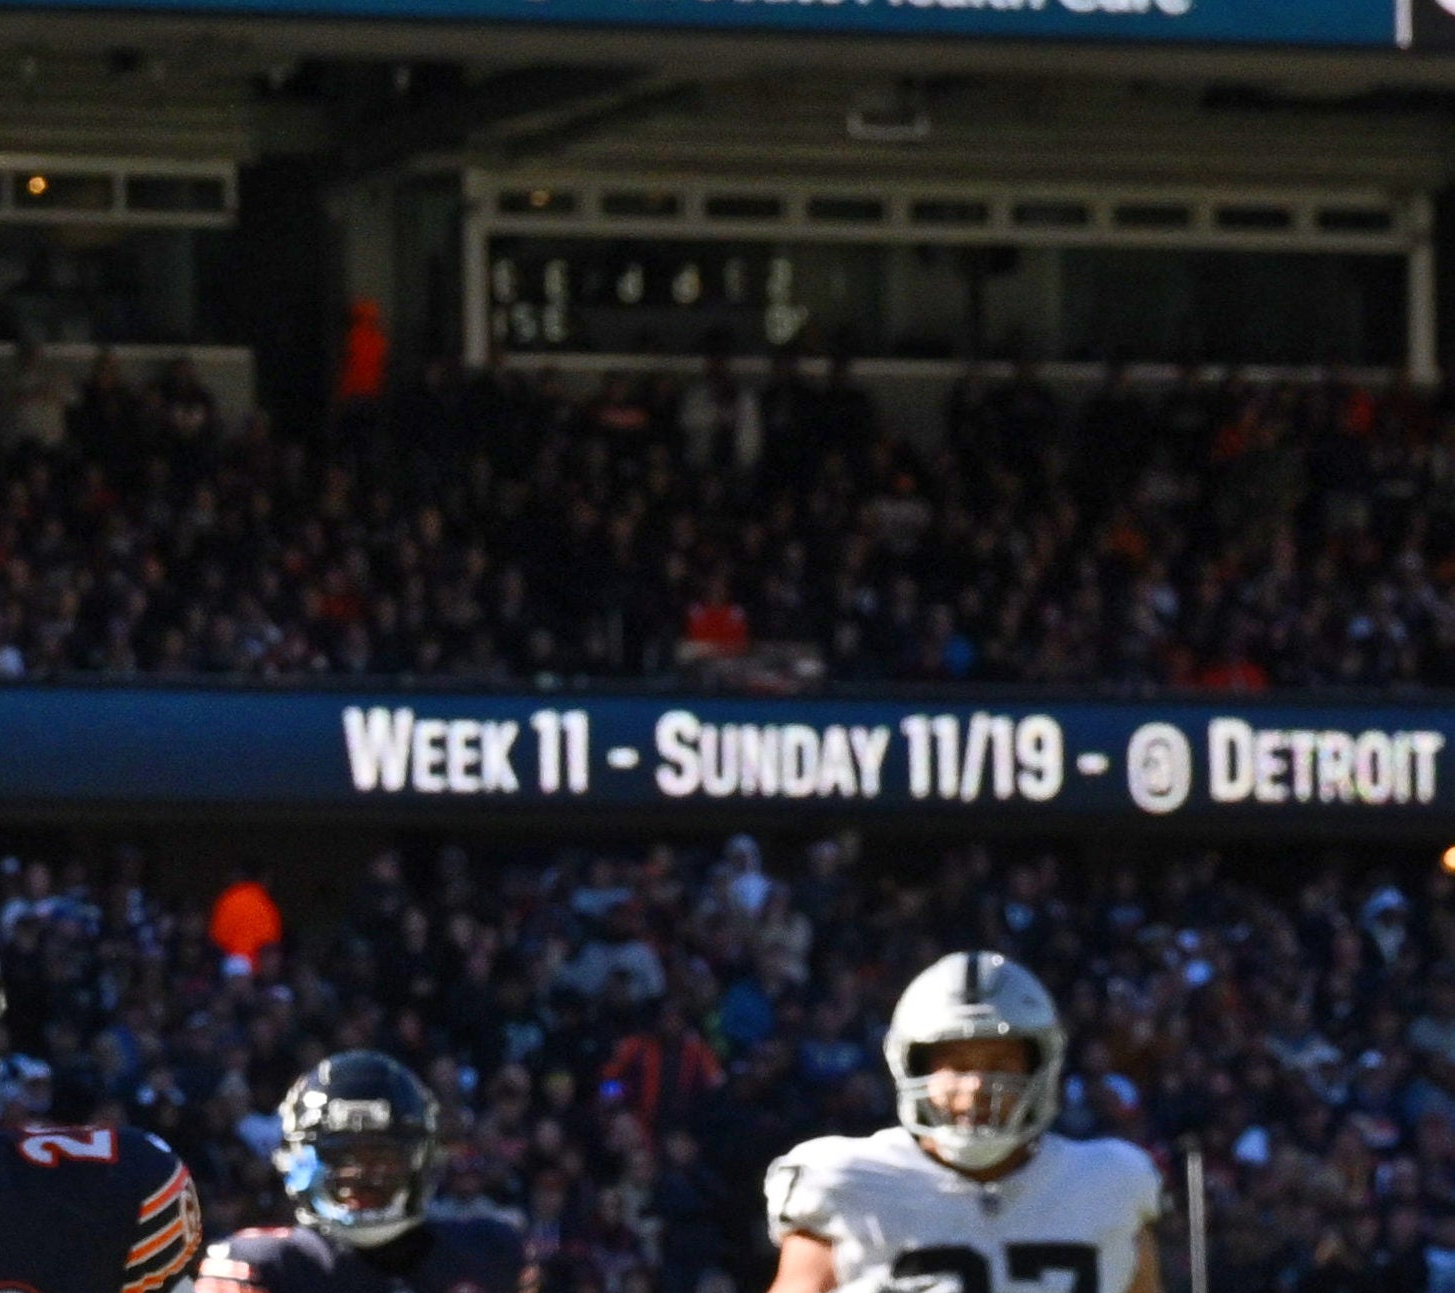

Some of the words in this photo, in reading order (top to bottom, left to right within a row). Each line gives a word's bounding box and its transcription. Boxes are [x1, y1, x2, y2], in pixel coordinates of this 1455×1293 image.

[529, 709, 590, 794] 11
[899, 711, 1065, 803] 11/19
[1126, 721, 1193, 814] @
